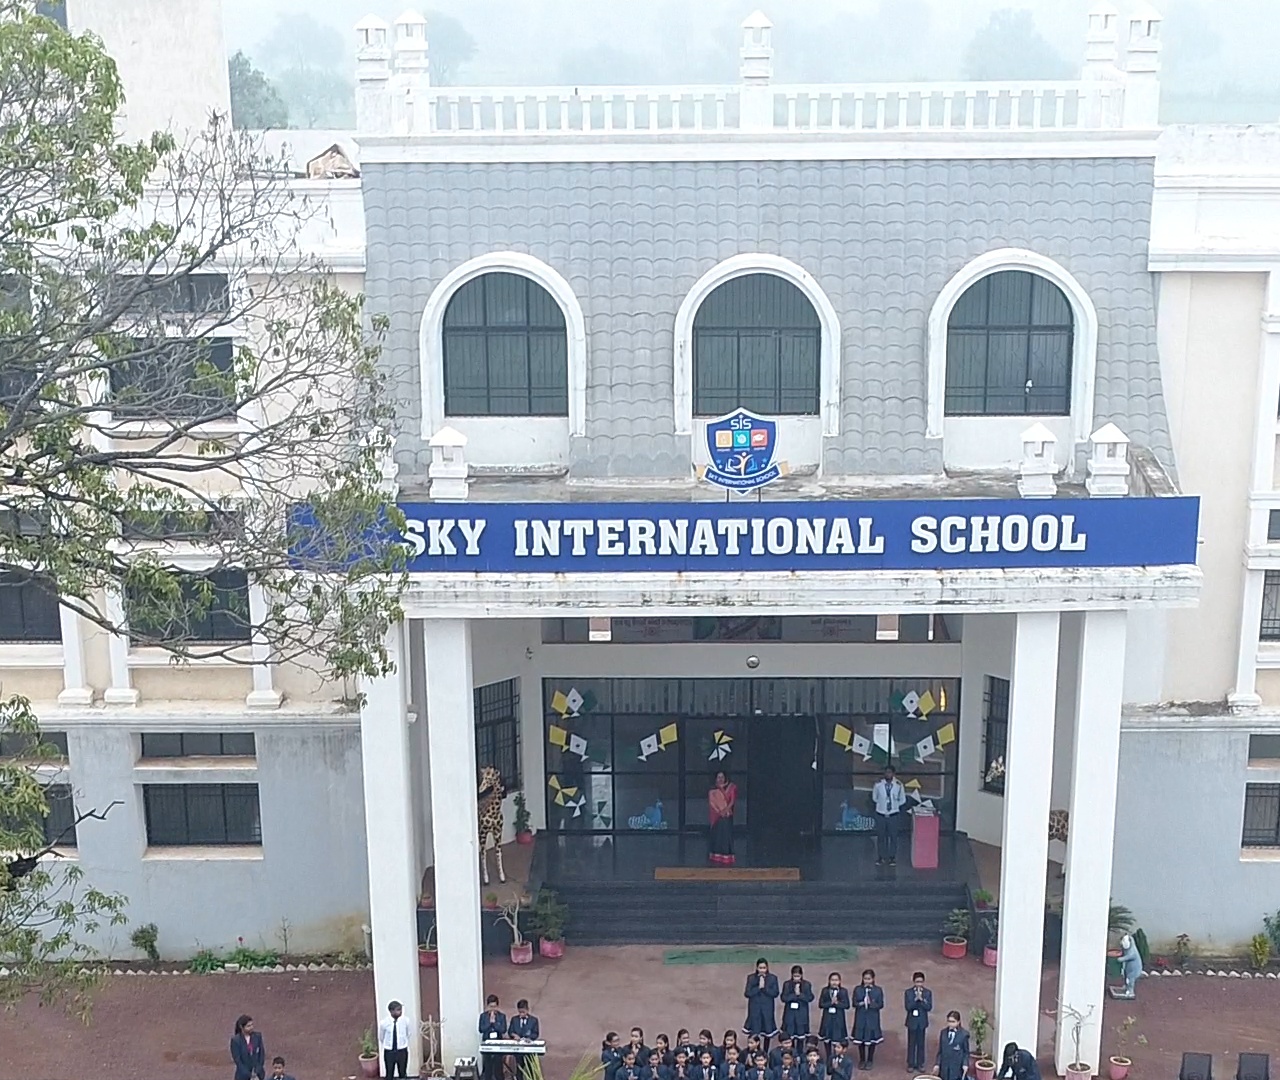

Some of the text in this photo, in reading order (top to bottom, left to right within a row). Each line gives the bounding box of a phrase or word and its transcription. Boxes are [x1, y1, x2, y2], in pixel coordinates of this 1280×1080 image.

[401, 514, 1087, 557] SKY INTERNATIONAL SCHOOL
